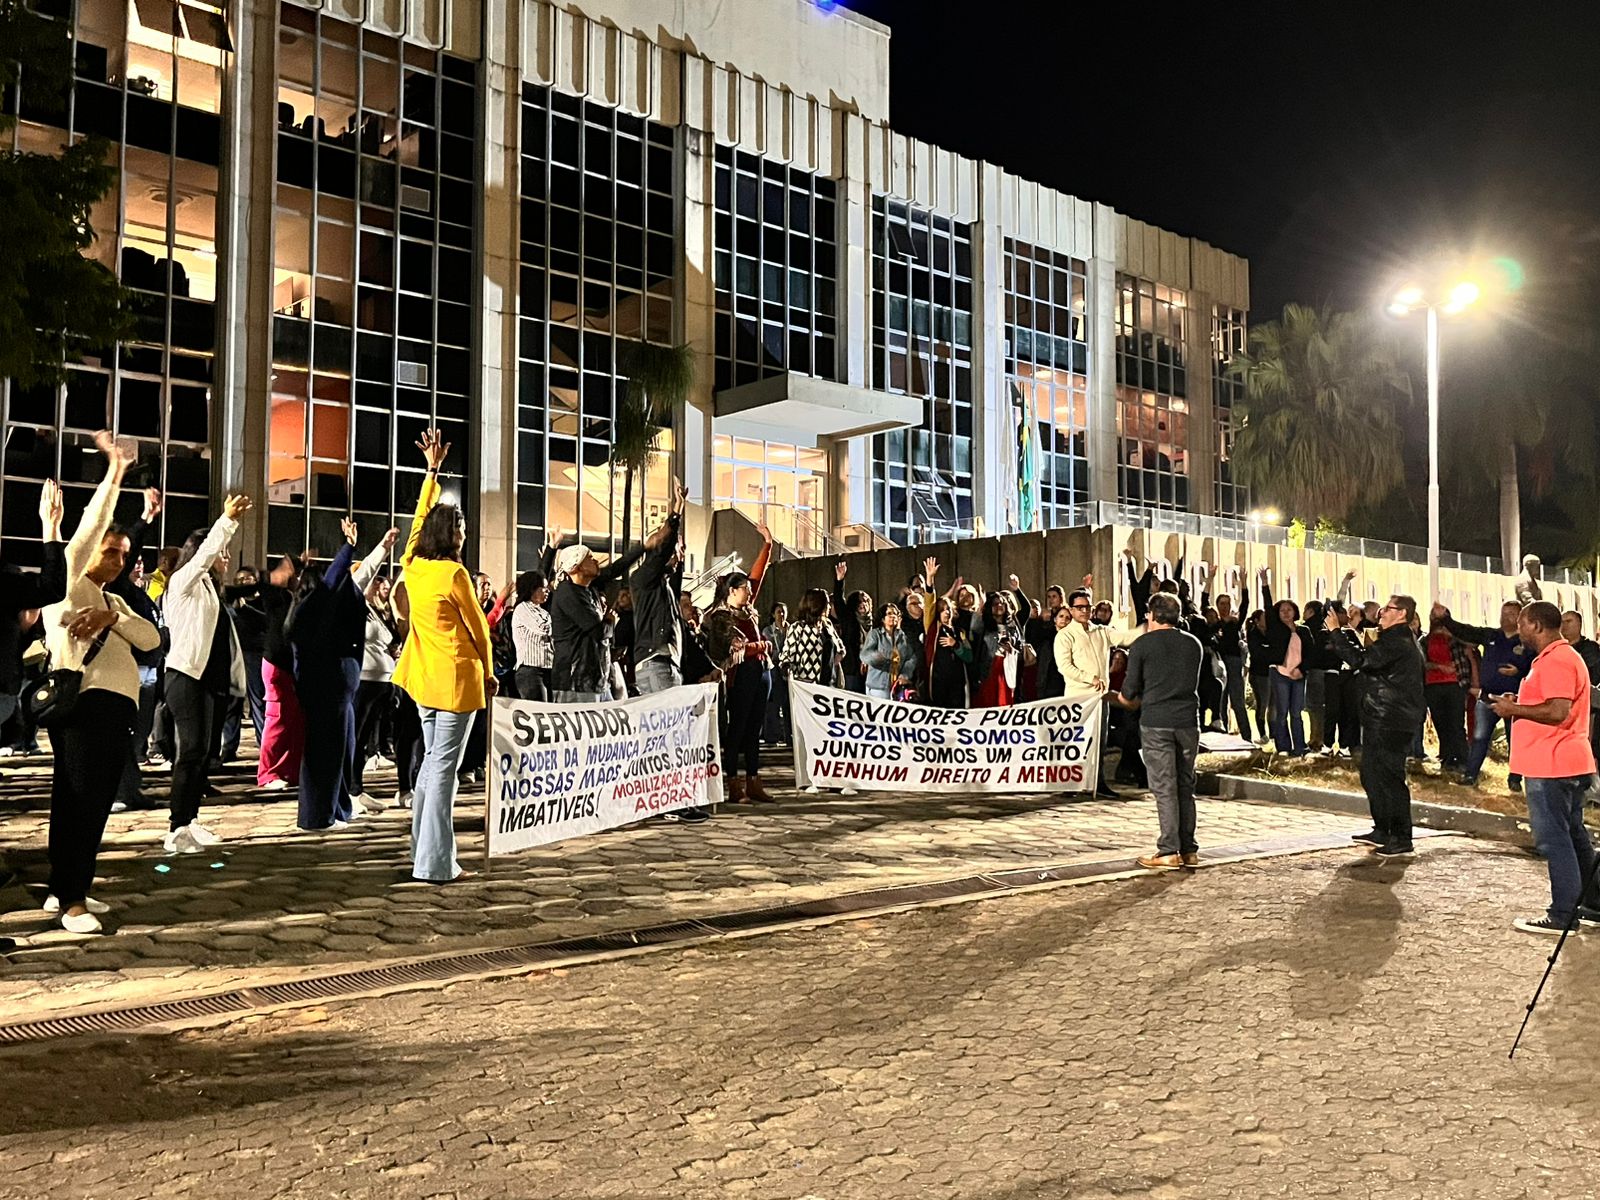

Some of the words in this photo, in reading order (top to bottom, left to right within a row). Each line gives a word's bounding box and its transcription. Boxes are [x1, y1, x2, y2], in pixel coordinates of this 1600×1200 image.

[811, 694, 968, 725] SERVIDORES
[512, 708, 636, 747] SERVIDOR,
[827, 721, 945, 744] SOZINHOS
[957, 728, 1035, 745] SOMOS
[1048, 726, 1085, 742] VOZ
[500, 753, 512, 776] O
[518, 750, 558, 774] PODER
[565, 747, 578, 768] DA
[586, 740, 639, 766] MUDANÇA
[813, 740, 901, 761] JUNTOS
[913, 745, 977, 763] SOMOS
[986, 747, 1012, 763] UM
[1022, 737, 1093, 761] GRITO!
[501, 771, 576, 801] NOSSAS
[675, 744, 716, 768] SOMOS
[612, 769, 682, 800] MOBILIZAÇÃO
[813, 759, 908, 781] NENHUM
[920, 767, 991, 783] DIREITO
[997, 767, 1010, 783] A
[1017, 765, 1083, 783] MENOS
[499, 789, 603, 834] IMBATÍVEIS!
[634, 783, 697, 813] AGORA!
